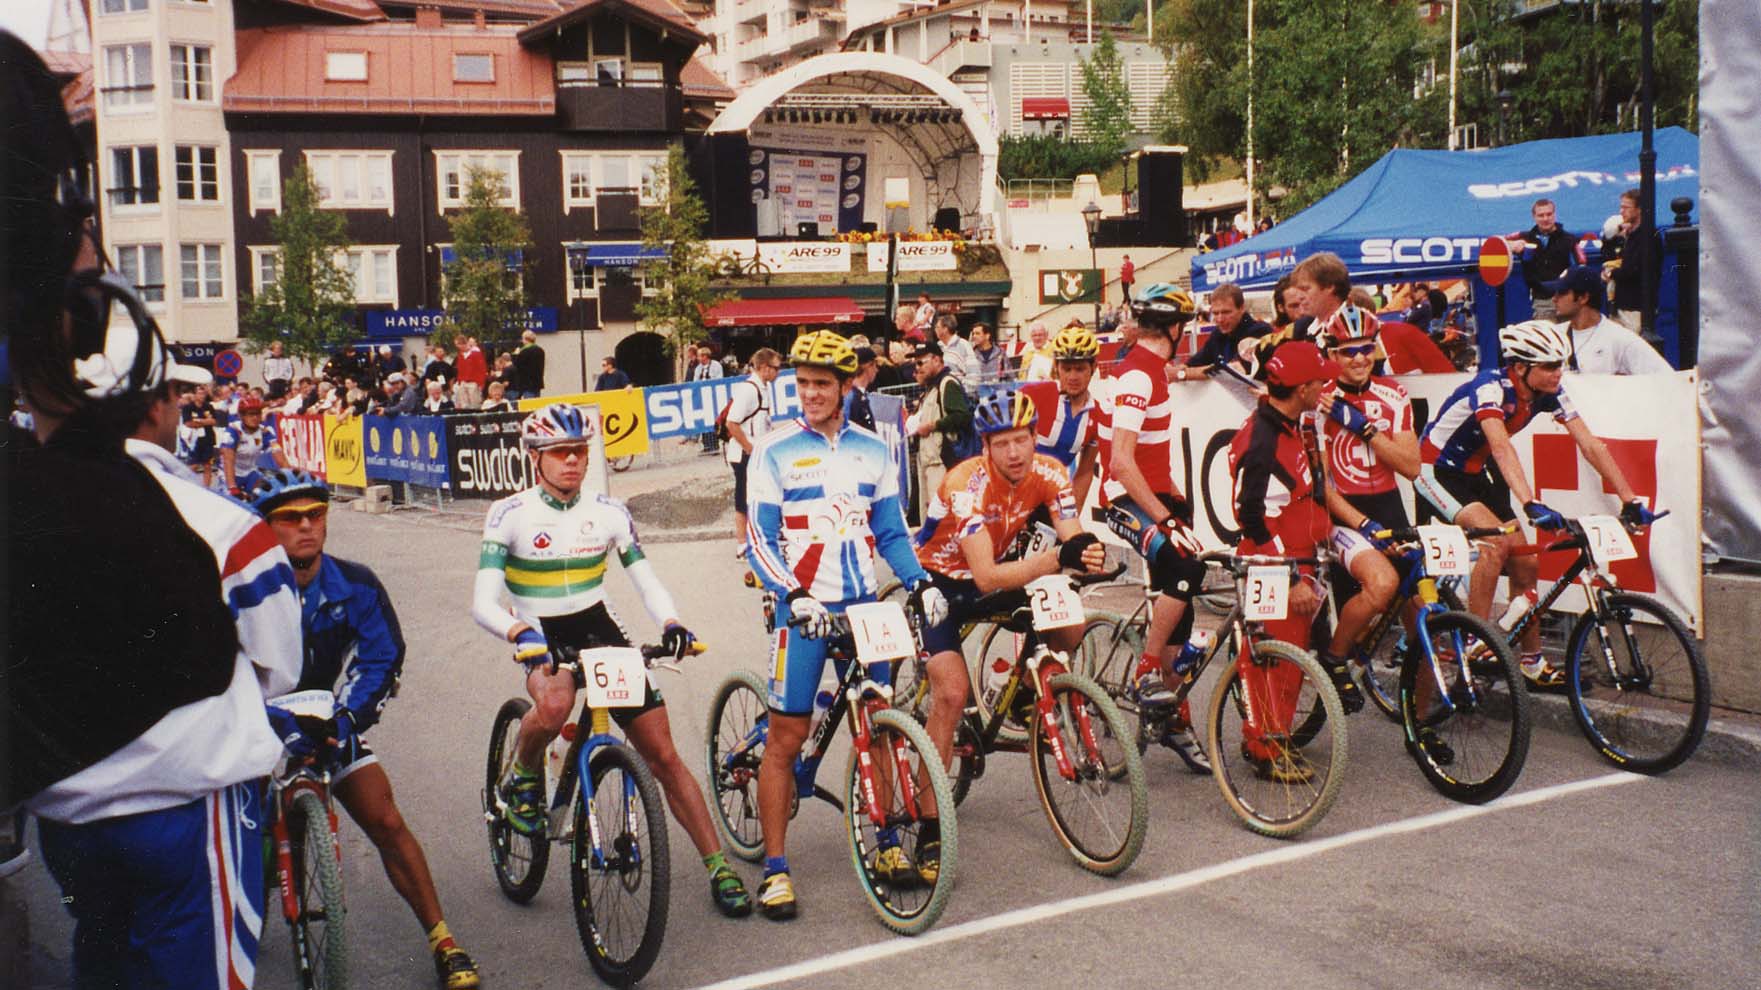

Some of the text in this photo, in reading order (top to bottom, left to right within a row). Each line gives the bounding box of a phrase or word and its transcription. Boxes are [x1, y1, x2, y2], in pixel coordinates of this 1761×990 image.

[823, 247, 841, 256] 99
[930, 246, 948, 255] 99
[1360, 237, 1484, 263] SCOT
[1204, 254, 1257, 285] SCOTT
[385, 315, 455, 327] HANSON
[649, 375, 804, 434] SHIA
[458, 437, 536, 491] swatch
[1430, 537, 1455, 560] 5 A
[1592, 526, 1602, 548] 7
[1035, 588, 1066, 612] 2 A
[1253, 580, 1276, 604] 3 A
[862, 619, 892, 644] 1 A
[594, 662, 626, 688] 6 A
